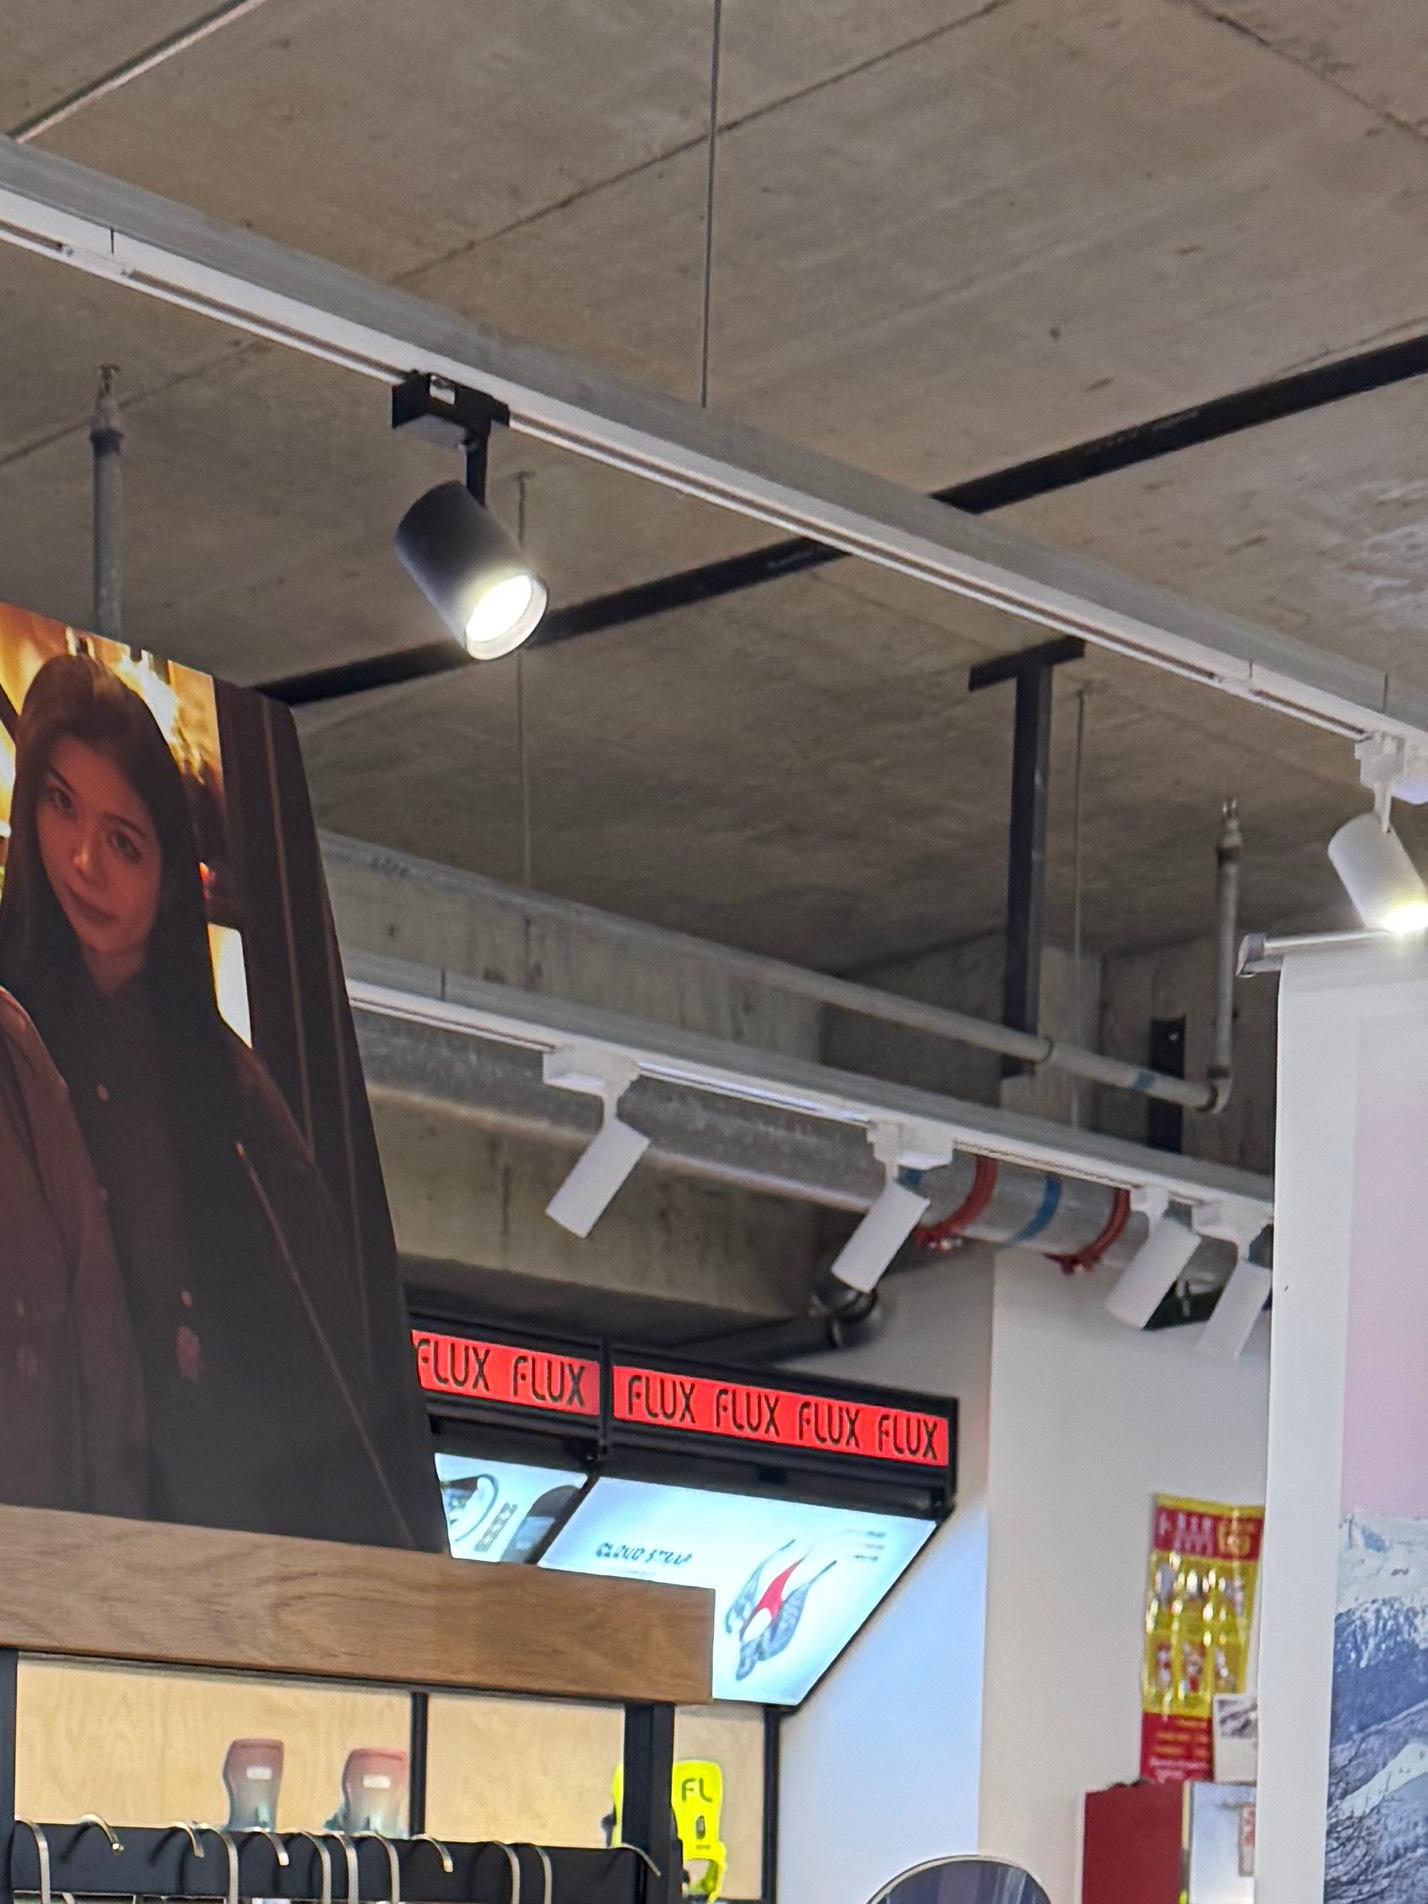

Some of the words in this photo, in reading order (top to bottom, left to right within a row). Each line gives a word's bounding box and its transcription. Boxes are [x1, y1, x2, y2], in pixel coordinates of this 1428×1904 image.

[512, 1356, 585, 1407] FLUX
[628, 1375, 695, 1425] FLUX
[716, 1389, 781, 1437] FLUX
[799, 1402, 860, 1449] FLUX
[877, 1415, 939, 1461] FLUX
[681, 1777, 714, 1802] FL
